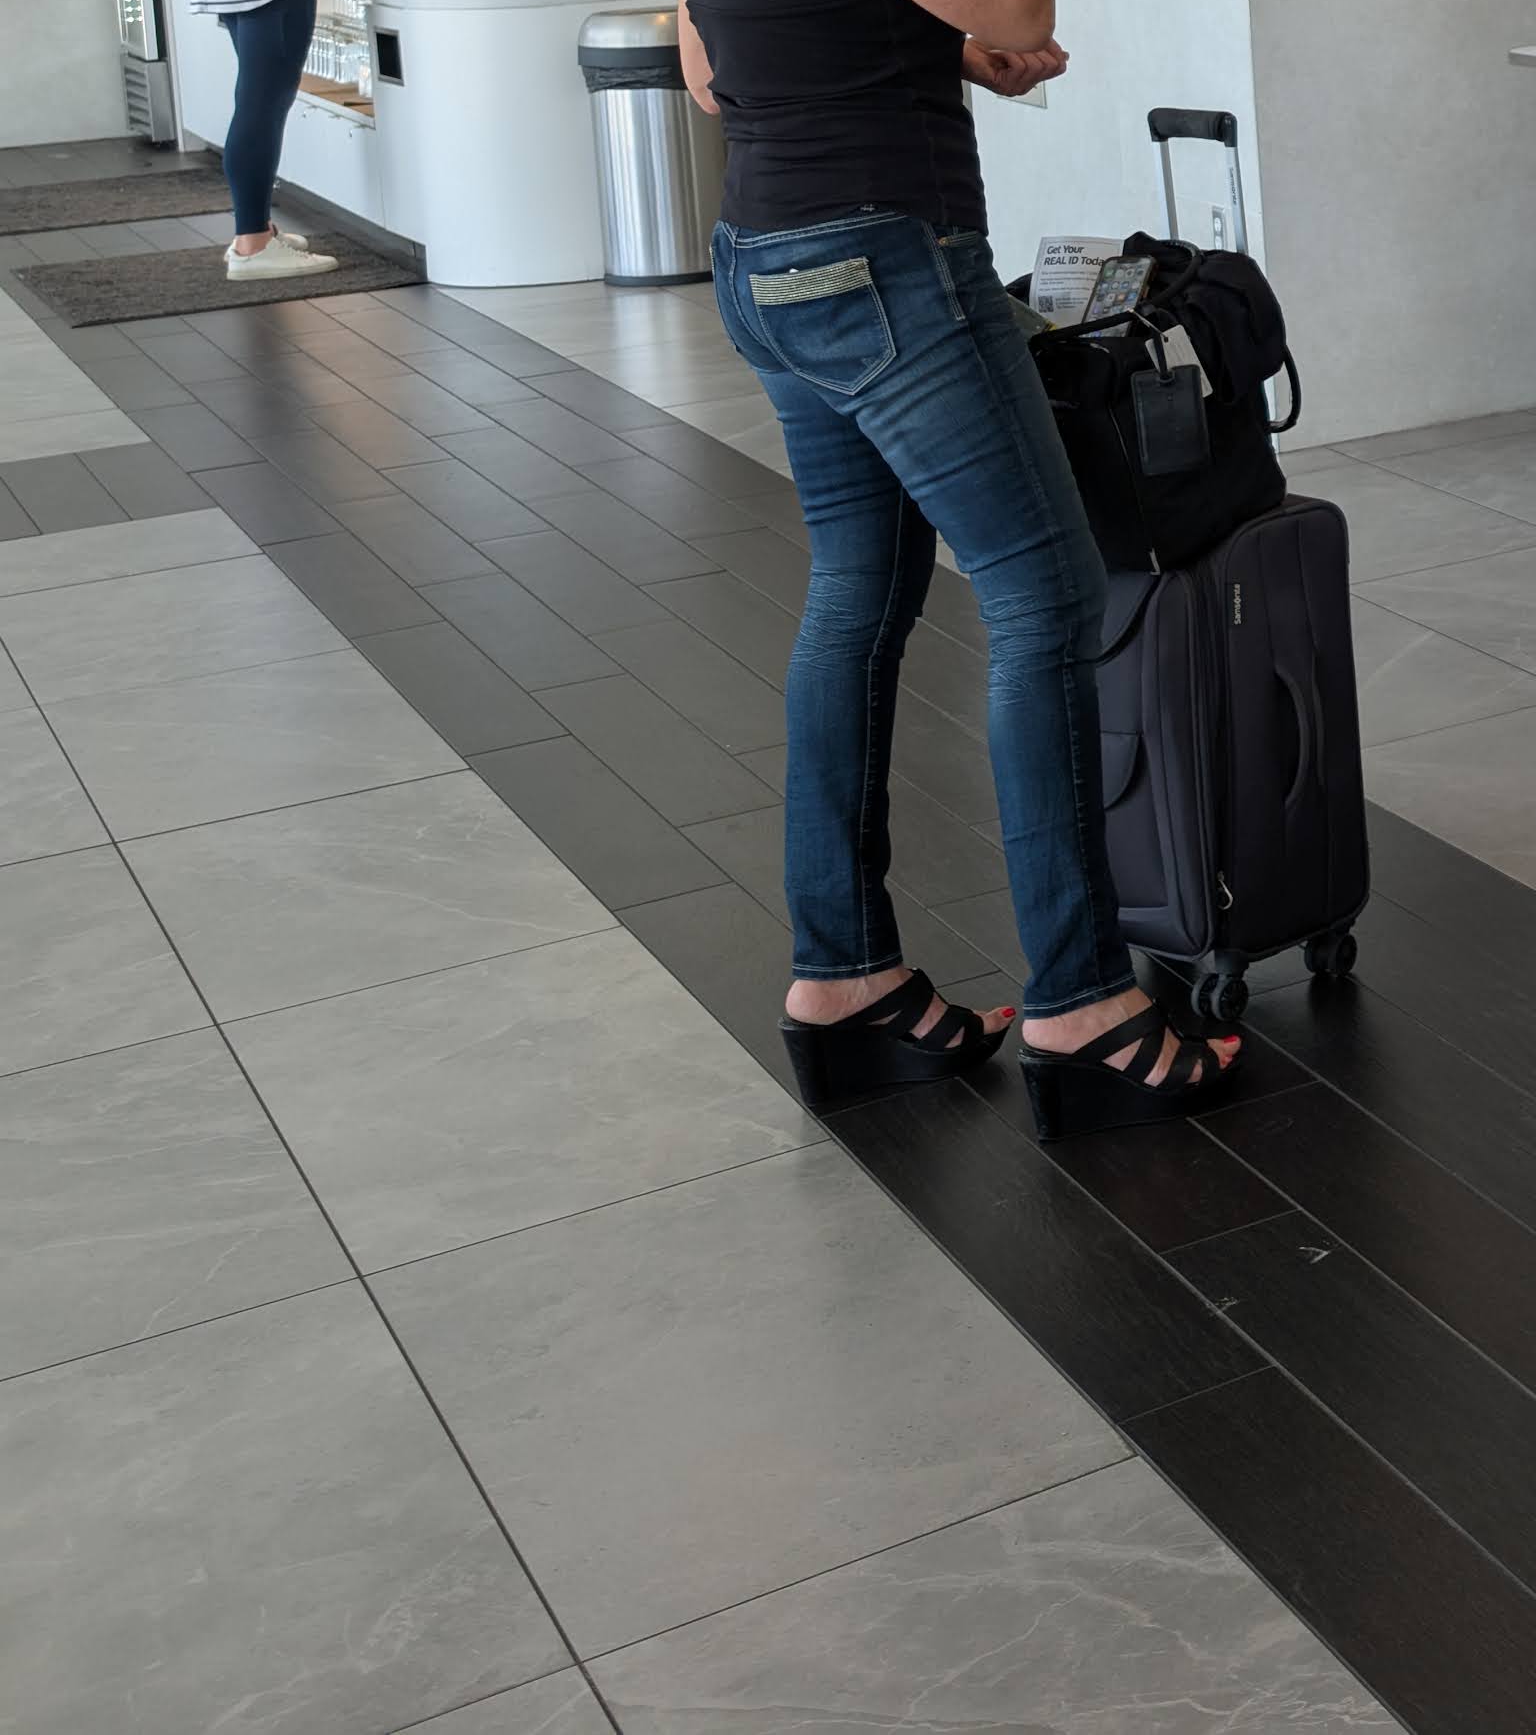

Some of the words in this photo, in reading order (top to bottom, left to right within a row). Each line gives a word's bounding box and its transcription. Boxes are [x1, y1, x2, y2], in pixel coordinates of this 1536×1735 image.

[1047, 246, 1062, 255] Get
[1063, 245, 1085, 254] Your
[1043, 256, 1067, 266] REAL
[1068, 256, 1079, 265] ID
[1081, 256, 1105, 267] Toda
